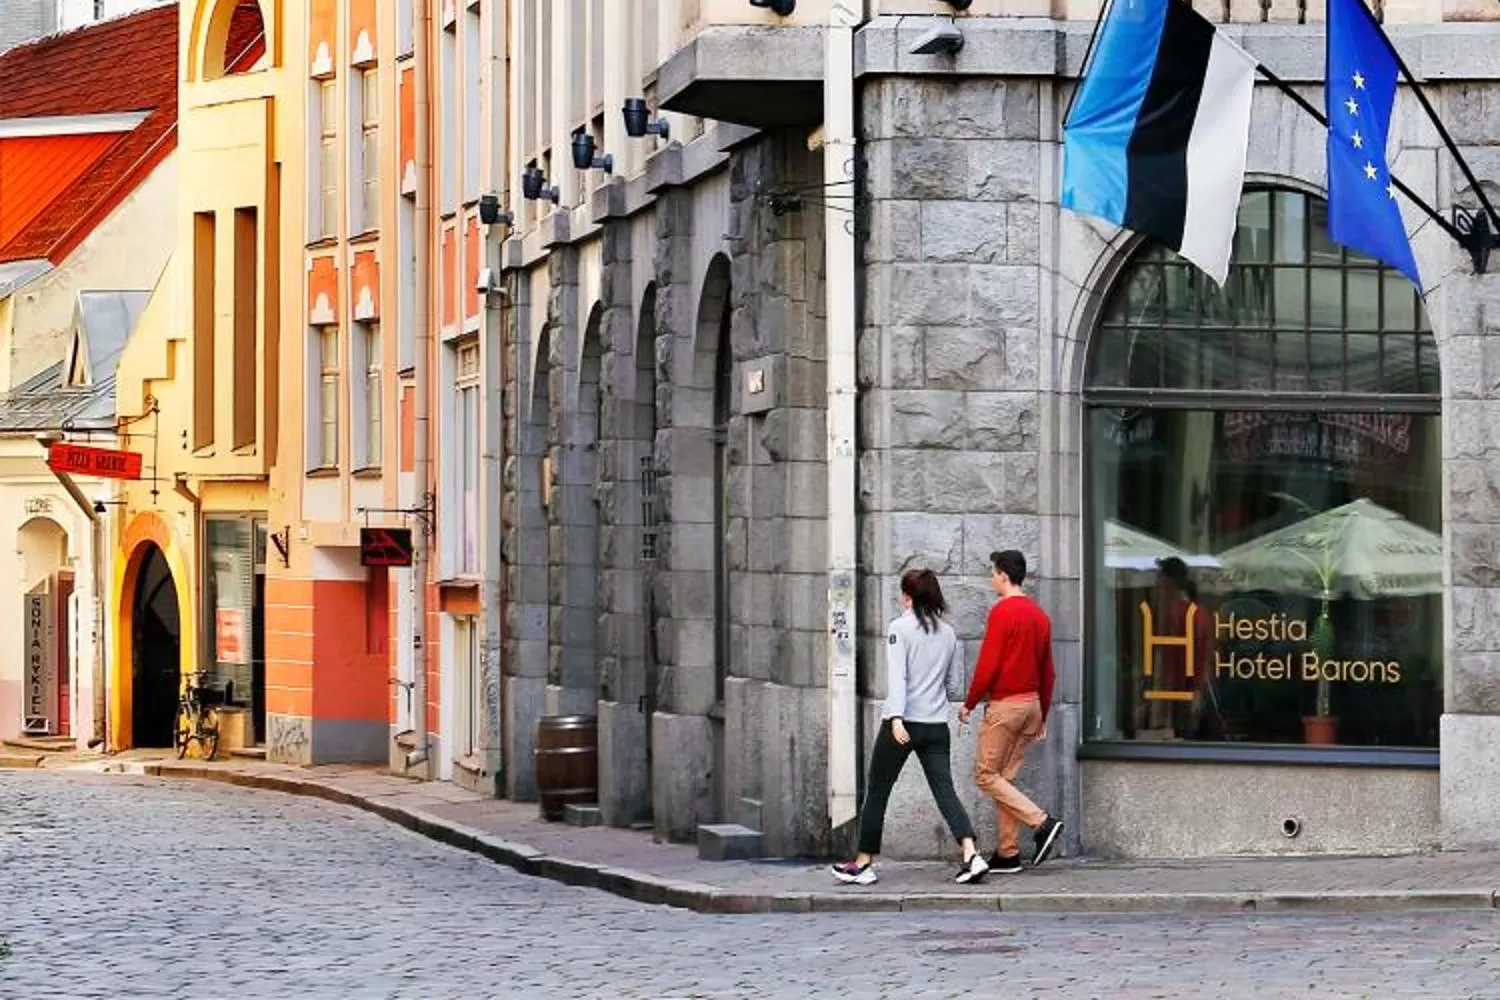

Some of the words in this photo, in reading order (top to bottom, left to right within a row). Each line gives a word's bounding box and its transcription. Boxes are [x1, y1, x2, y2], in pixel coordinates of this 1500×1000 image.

[1139, 600, 1198, 678] H
[1214, 611, 1308, 642] Hestia
[1214, 651, 1292, 680] Hotel
[1302, 652, 1402, 684] Barons
